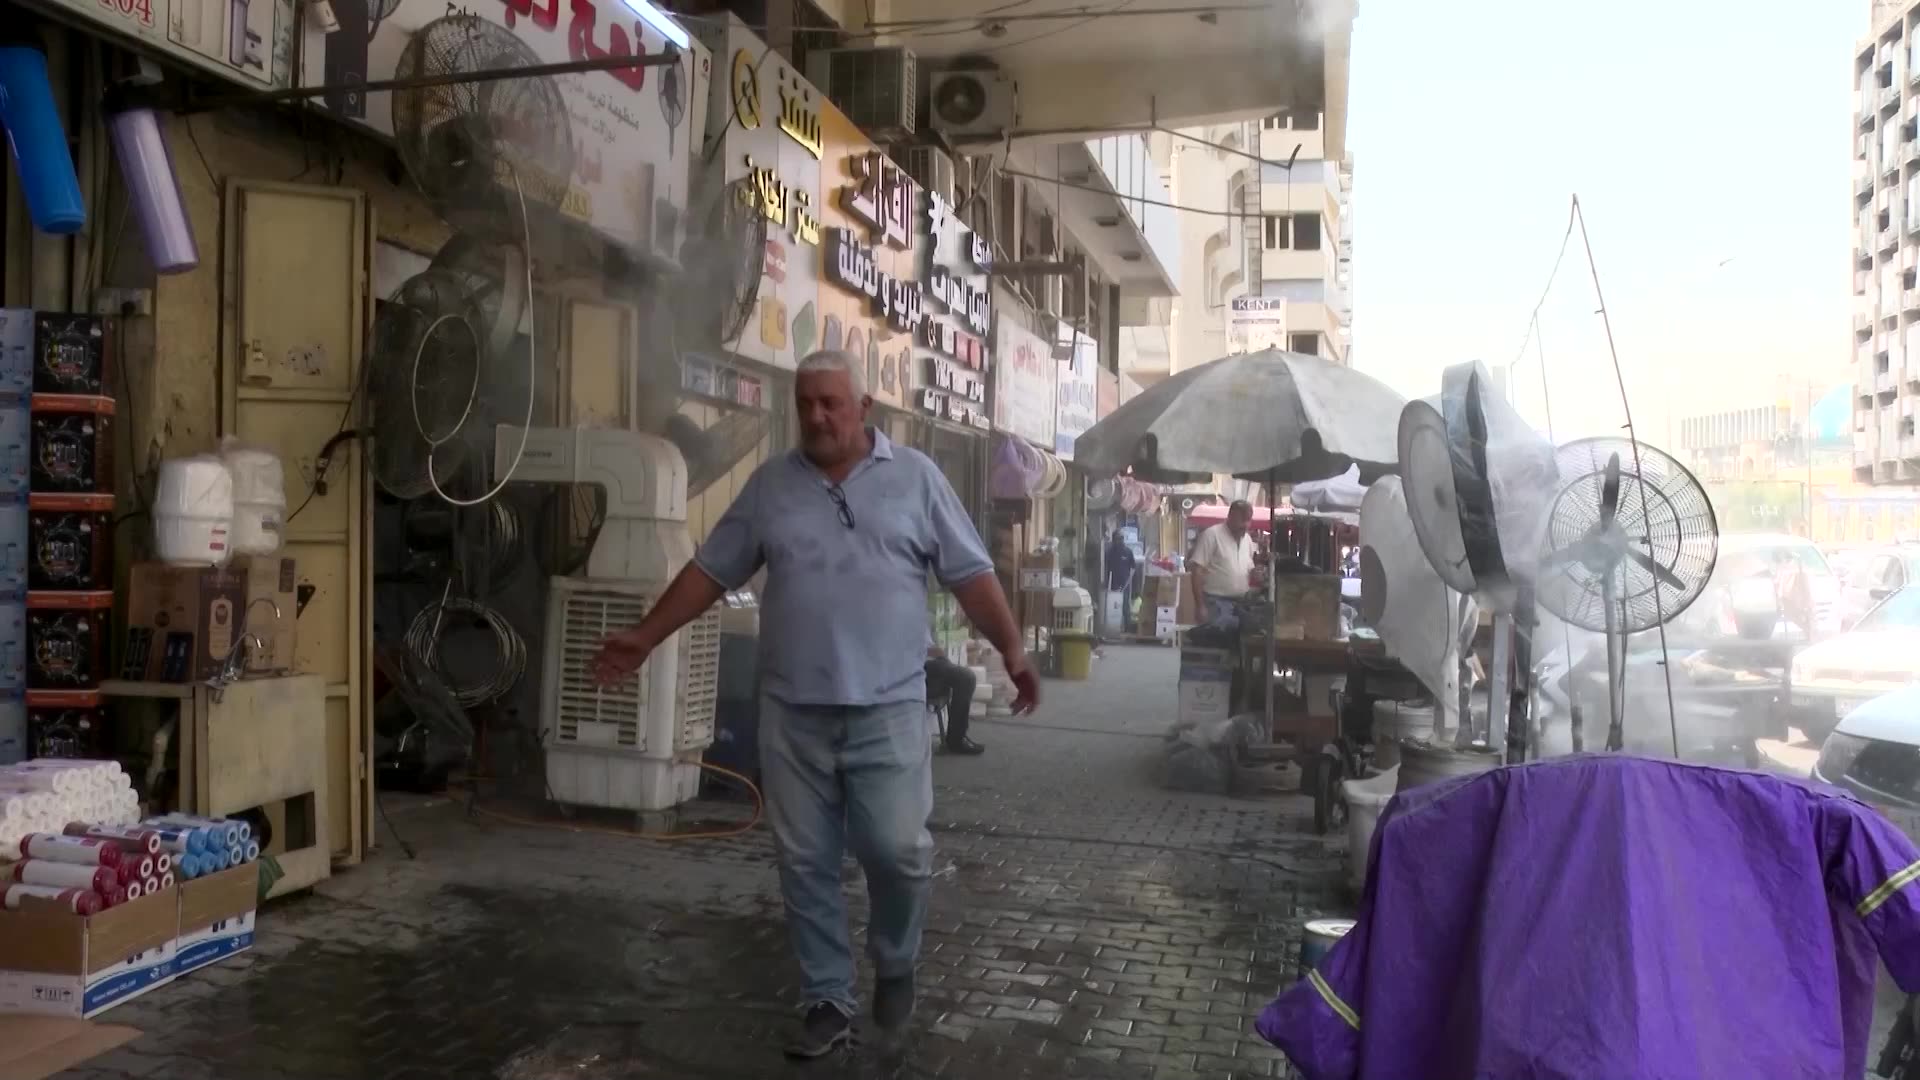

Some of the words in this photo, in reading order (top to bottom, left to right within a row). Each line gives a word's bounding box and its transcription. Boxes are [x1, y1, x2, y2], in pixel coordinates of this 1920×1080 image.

[845, 151, 914, 250] الفرات
[894, 280, 924, 333] تبريد
[1237, 299, 1273, 310] KENT
